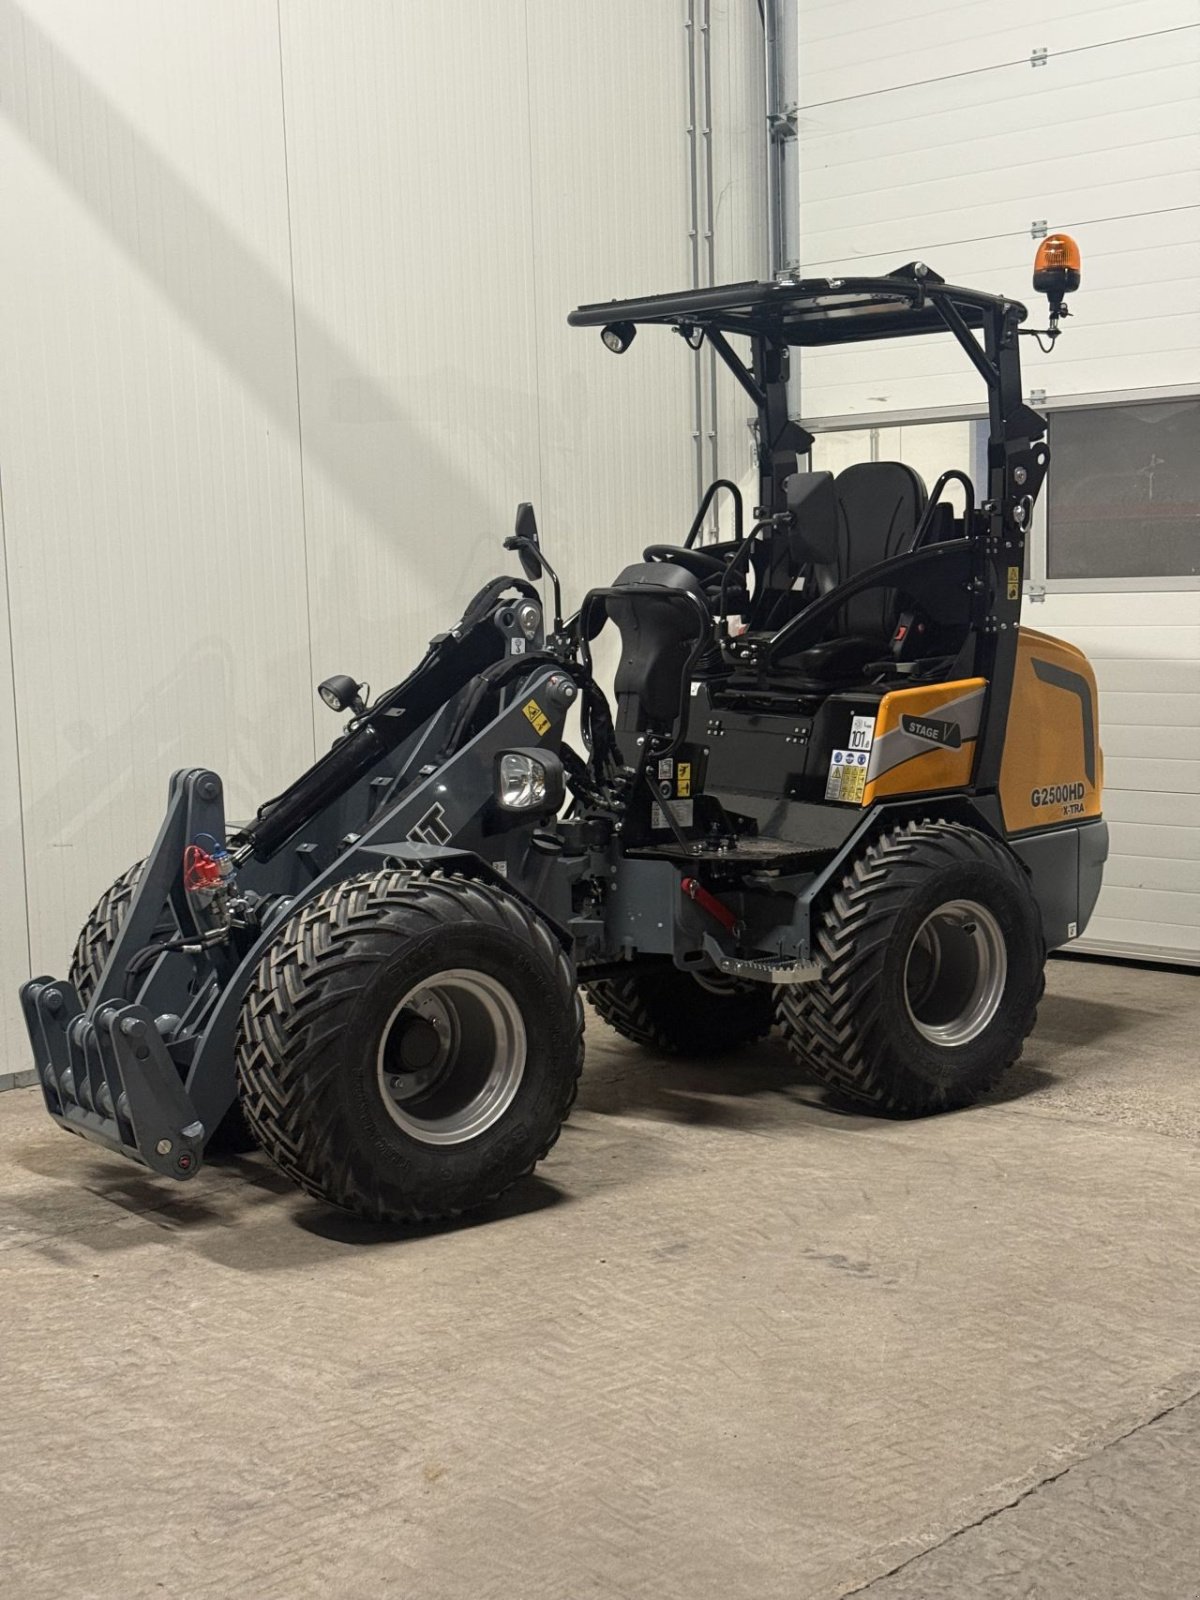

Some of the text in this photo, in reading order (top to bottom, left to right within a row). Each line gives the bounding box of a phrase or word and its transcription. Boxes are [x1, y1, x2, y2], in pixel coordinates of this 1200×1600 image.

[851, 730, 866, 748] 101
[908, 722, 940, 740] STAGE
[1031, 782, 1085, 807] G2500HD
[1063, 802, 1085, 816] X-TRA
